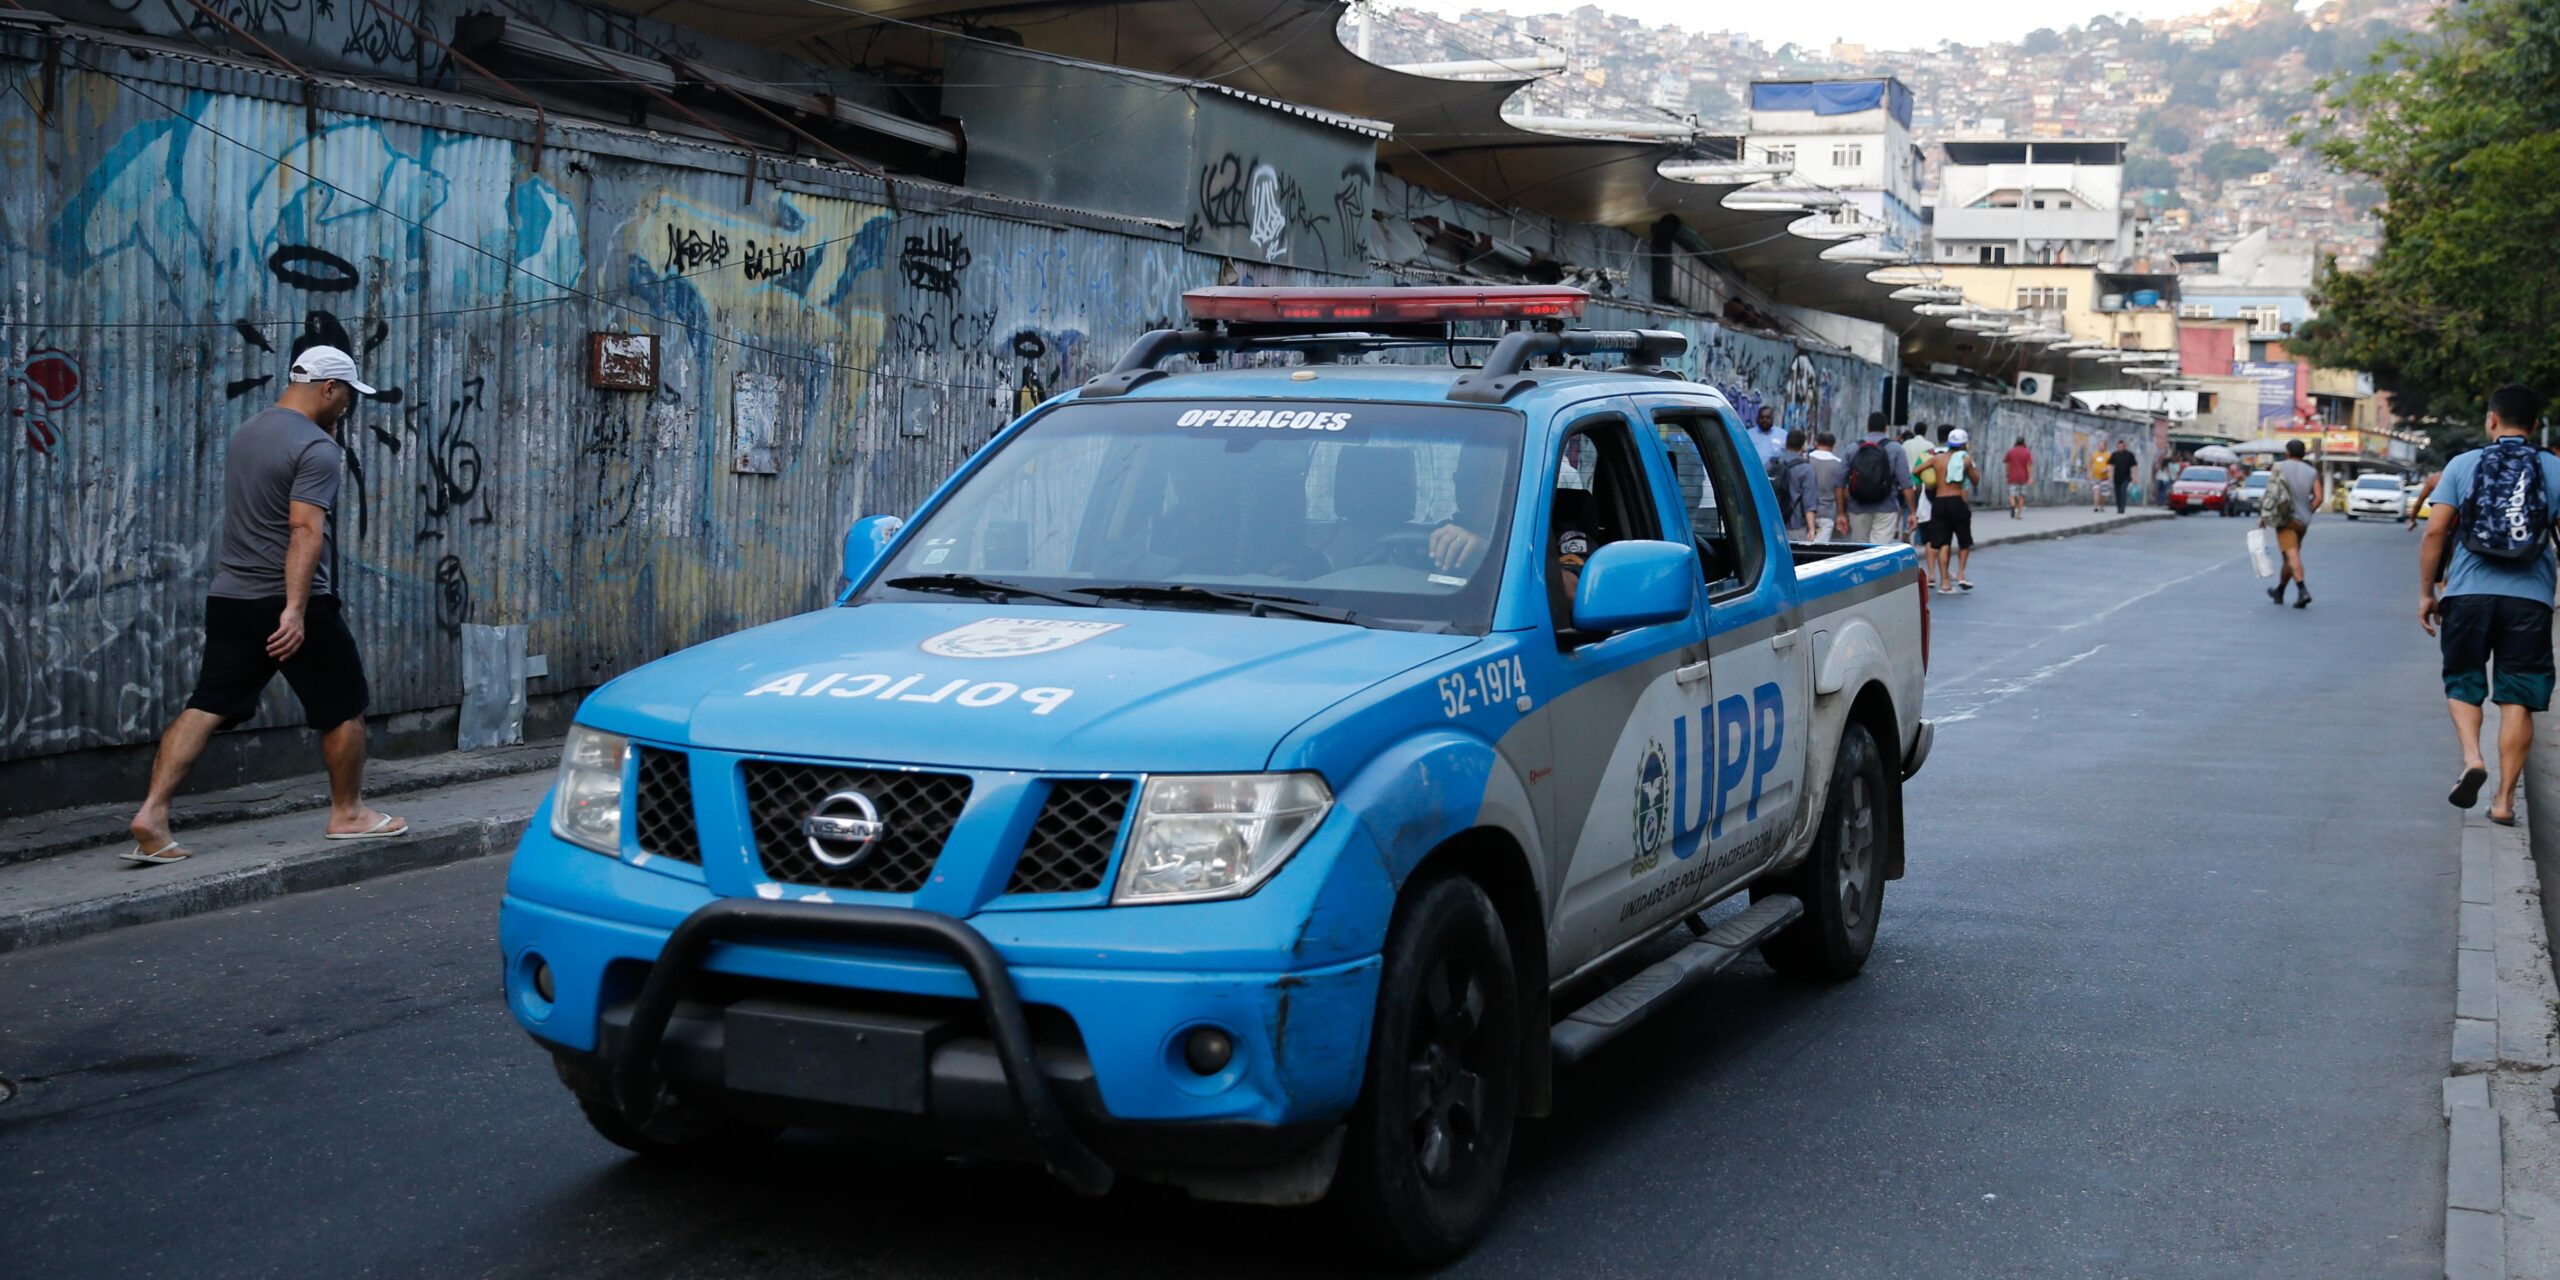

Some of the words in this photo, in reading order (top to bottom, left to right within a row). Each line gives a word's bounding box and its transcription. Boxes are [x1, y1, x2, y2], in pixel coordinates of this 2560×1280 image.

[1176, 409, 1352, 431] OPERACOES
[1438, 654, 1527, 718] 52-1974
[1671, 681, 1785, 860] UPP
[808, 820, 870, 836] NISSAN
[1620, 885, 1667, 922] UNIDADE
[1665, 876, 1681, 899] DE
